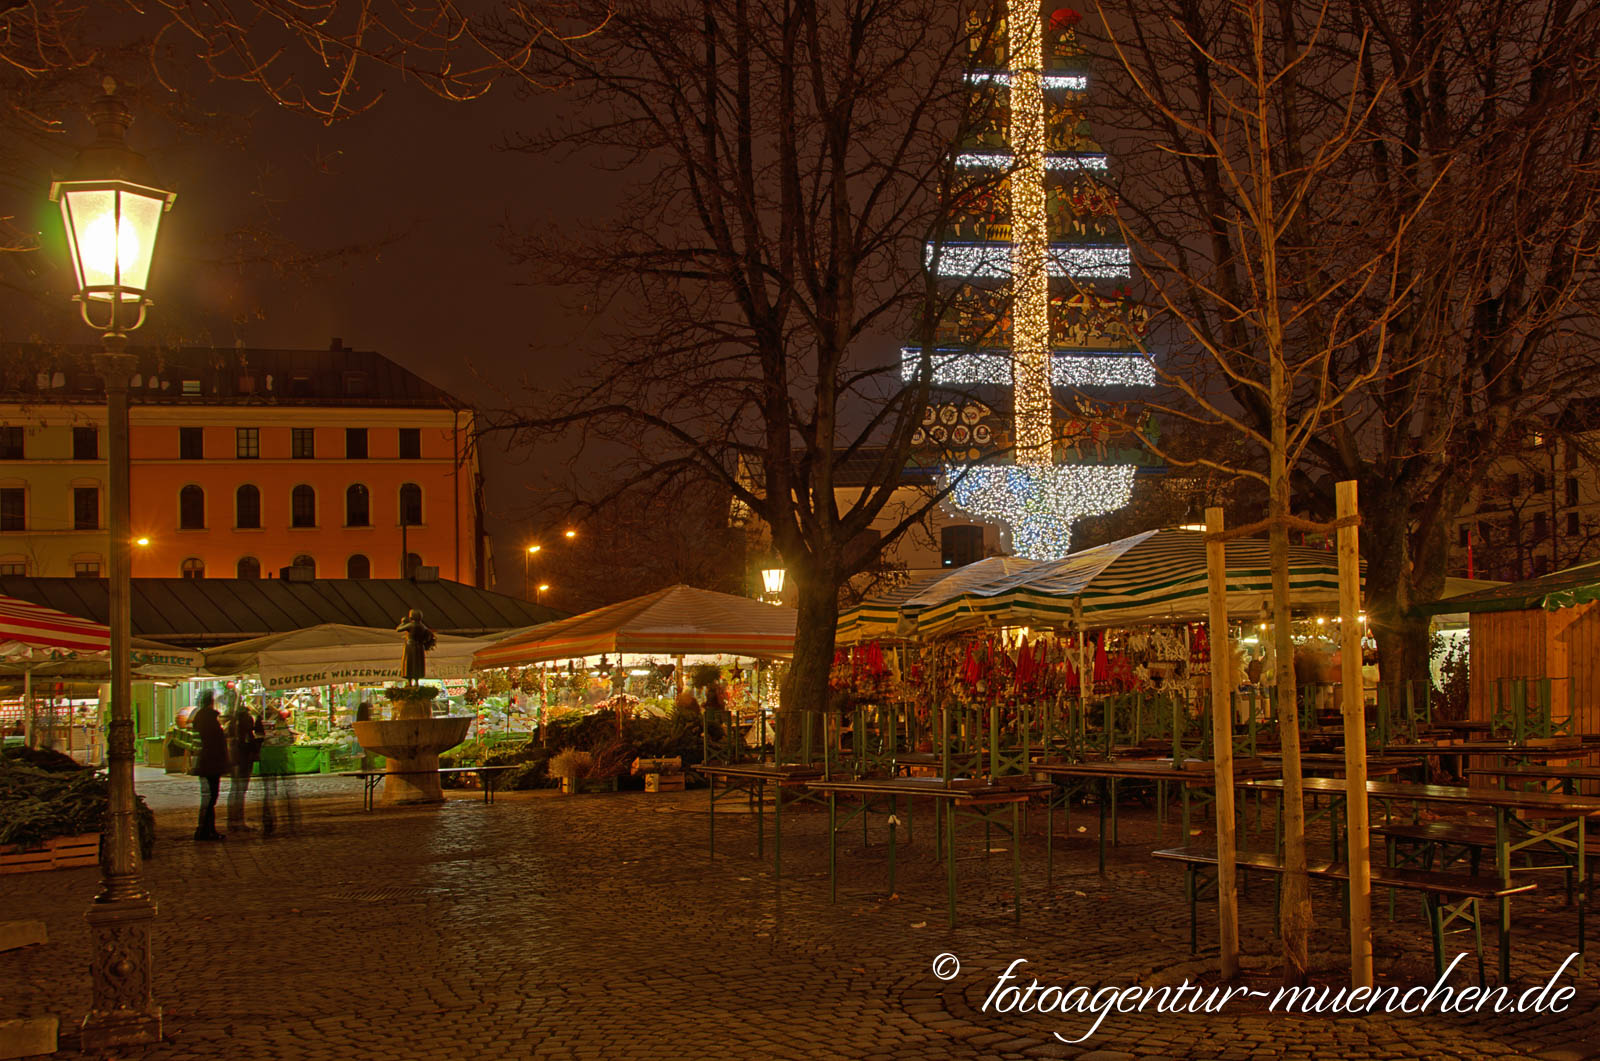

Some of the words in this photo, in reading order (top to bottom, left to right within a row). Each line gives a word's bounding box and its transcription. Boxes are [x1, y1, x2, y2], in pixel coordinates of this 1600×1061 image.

[129, 650, 194, 665] Kräuter
[269, 671, 327, 686] DEUTSCHE
[331, 668, 403, 679] WINZERWEIN
